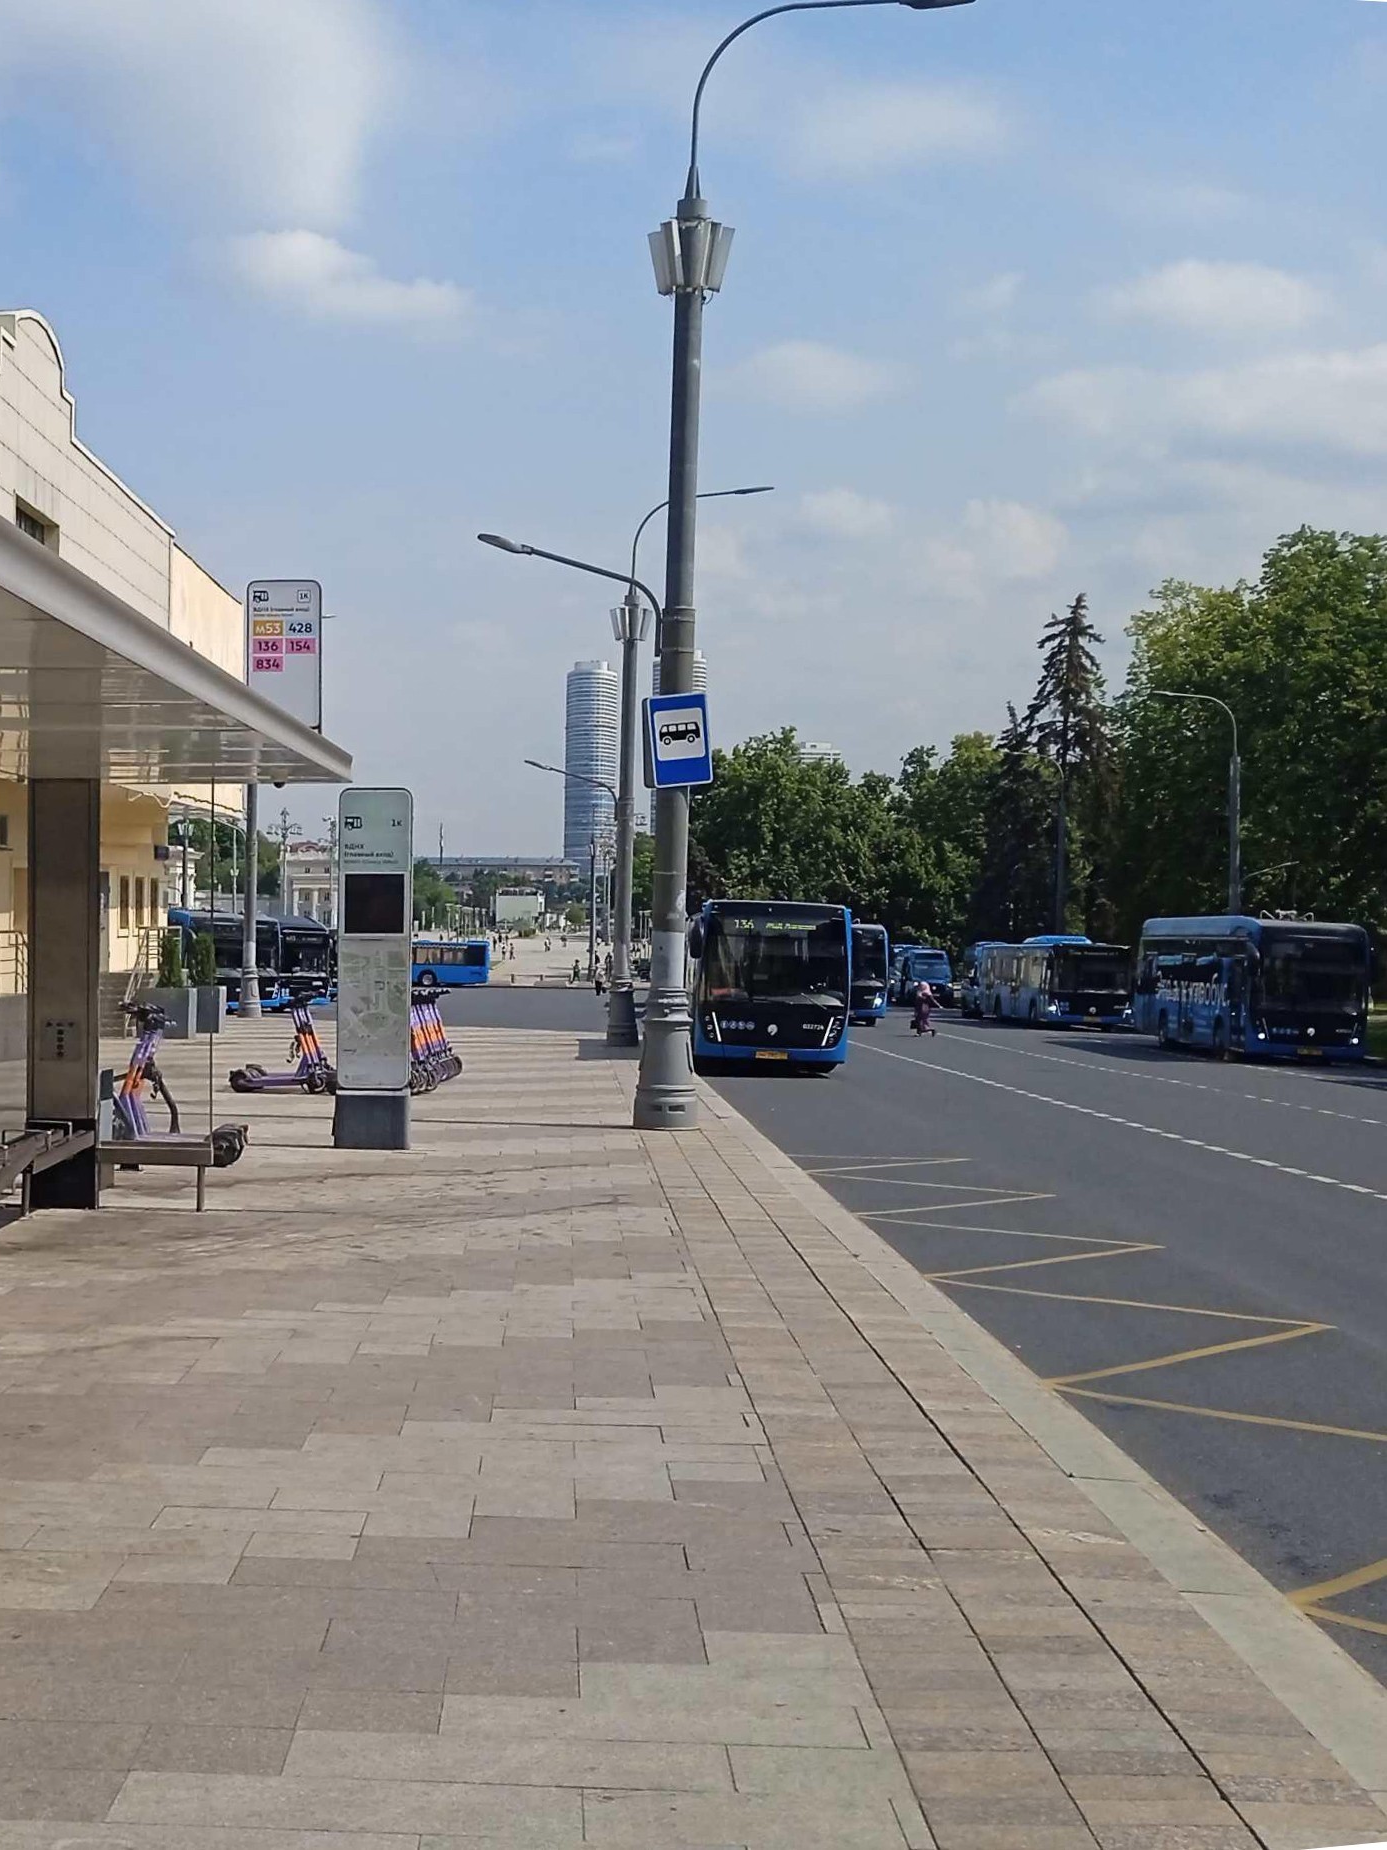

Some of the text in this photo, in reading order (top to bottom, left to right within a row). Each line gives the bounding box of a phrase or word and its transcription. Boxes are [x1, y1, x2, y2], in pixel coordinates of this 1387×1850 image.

[255, 622, 313, 634] м53 428
[257, 640, 311, 652] 136 154
[256, 658, 280, 670] 834
